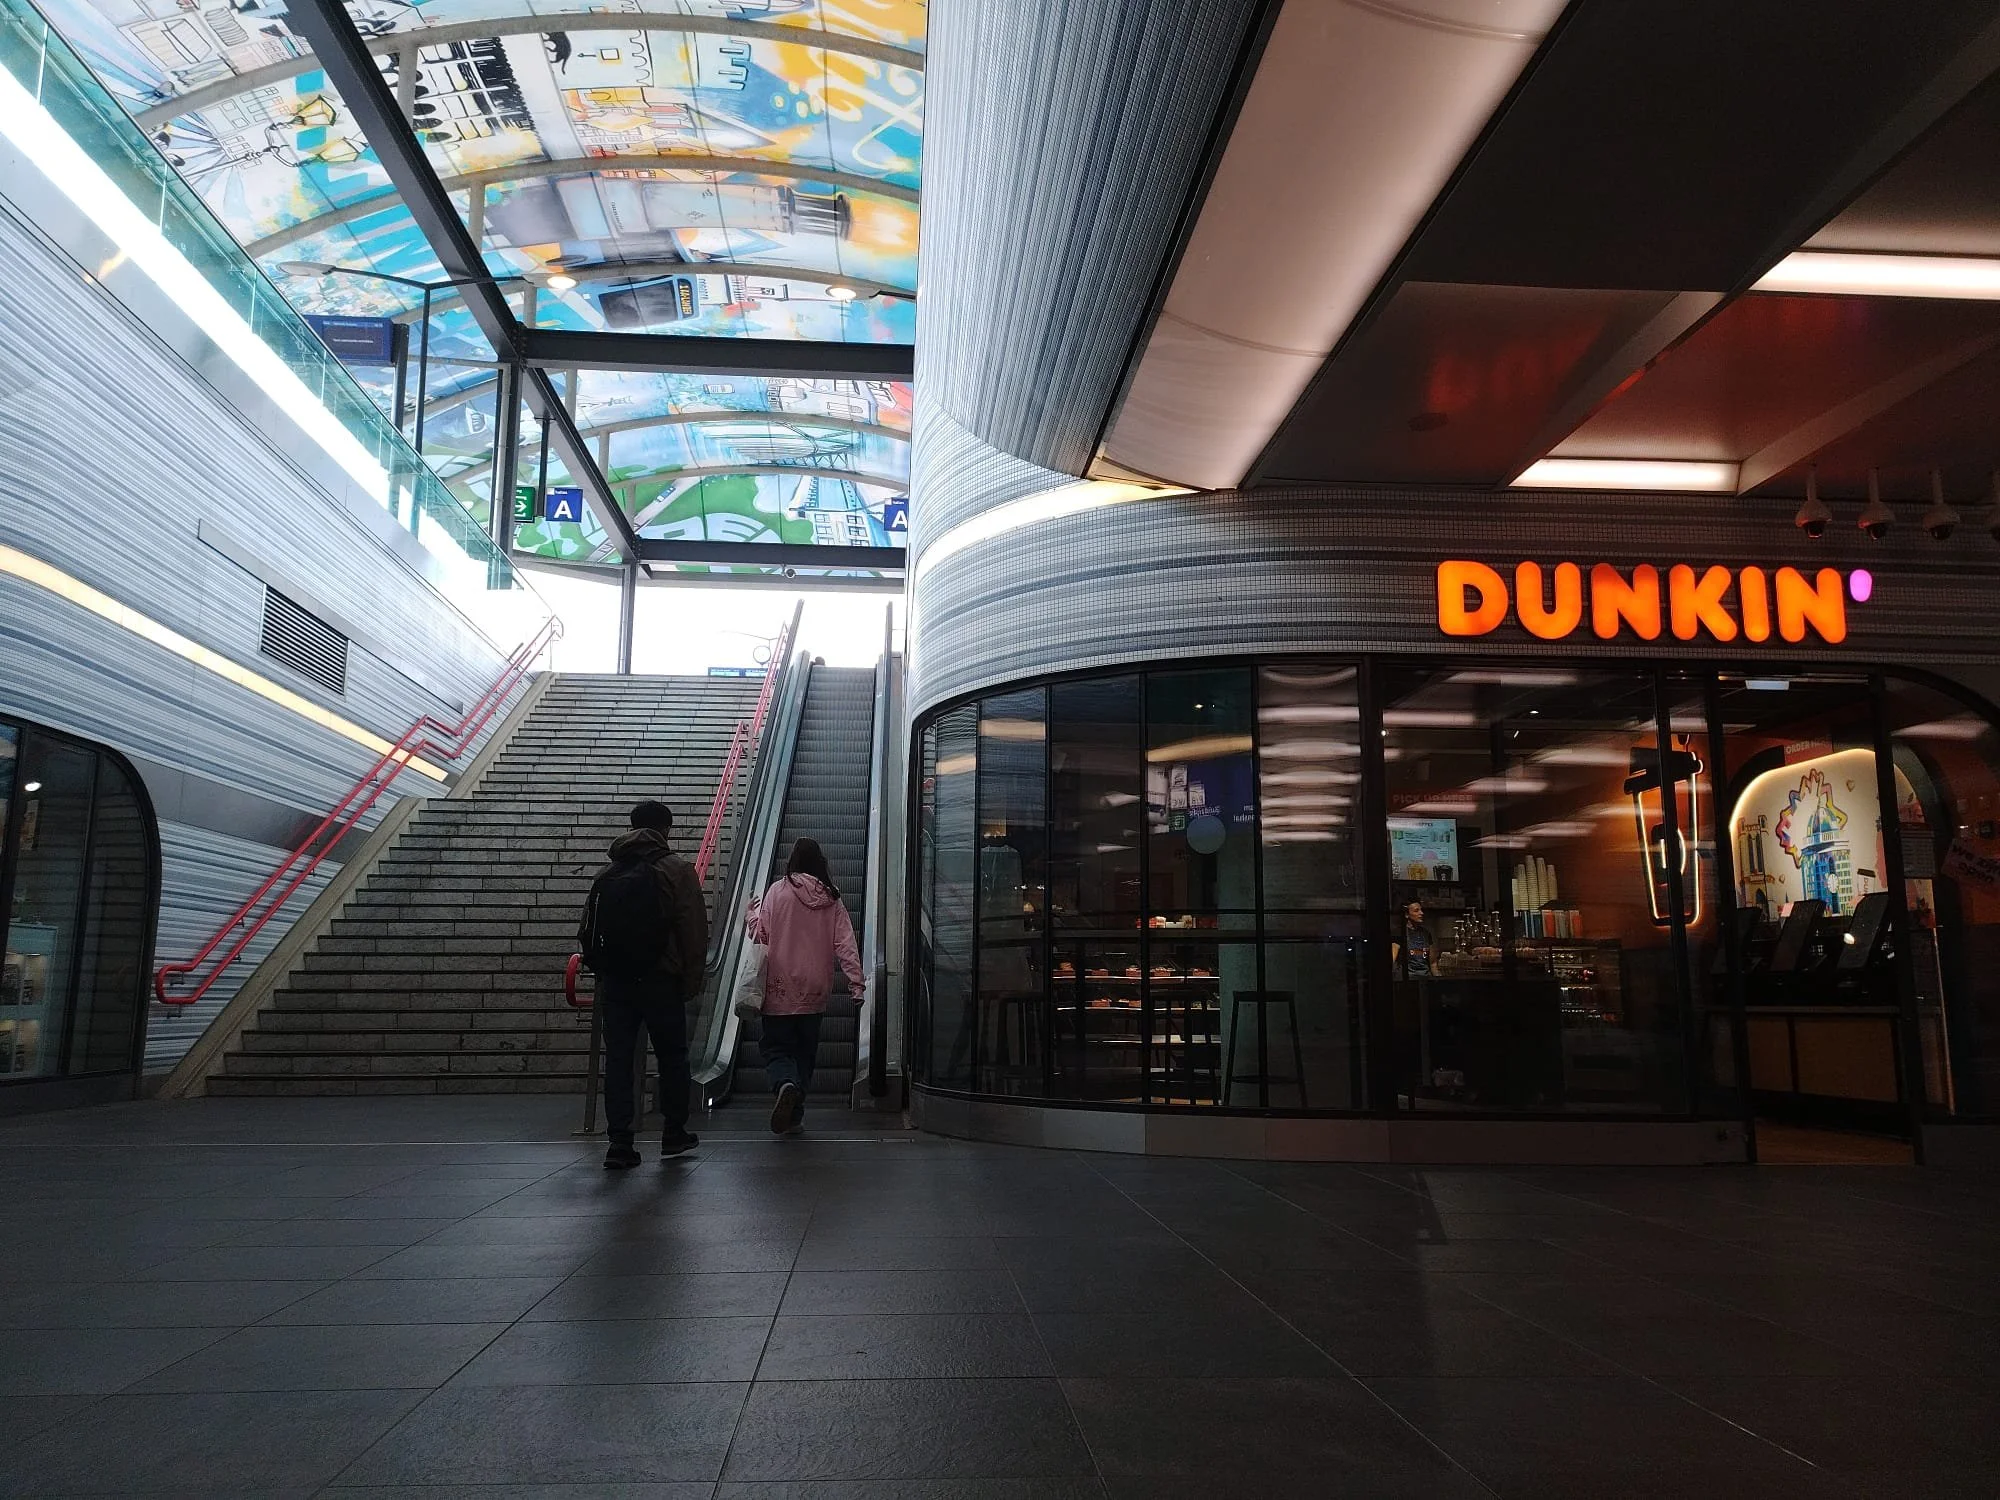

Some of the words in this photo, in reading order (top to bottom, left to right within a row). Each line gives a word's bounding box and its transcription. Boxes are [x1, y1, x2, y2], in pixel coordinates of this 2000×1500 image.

[553, 500, 573, 519] A
[891, 510, 908, 528] A
[1437, 560, 1873, 644] DUNKIN'
[1786, 740, 1810, 755] ORDER
[1392, 793, 1420, 804] PICK
